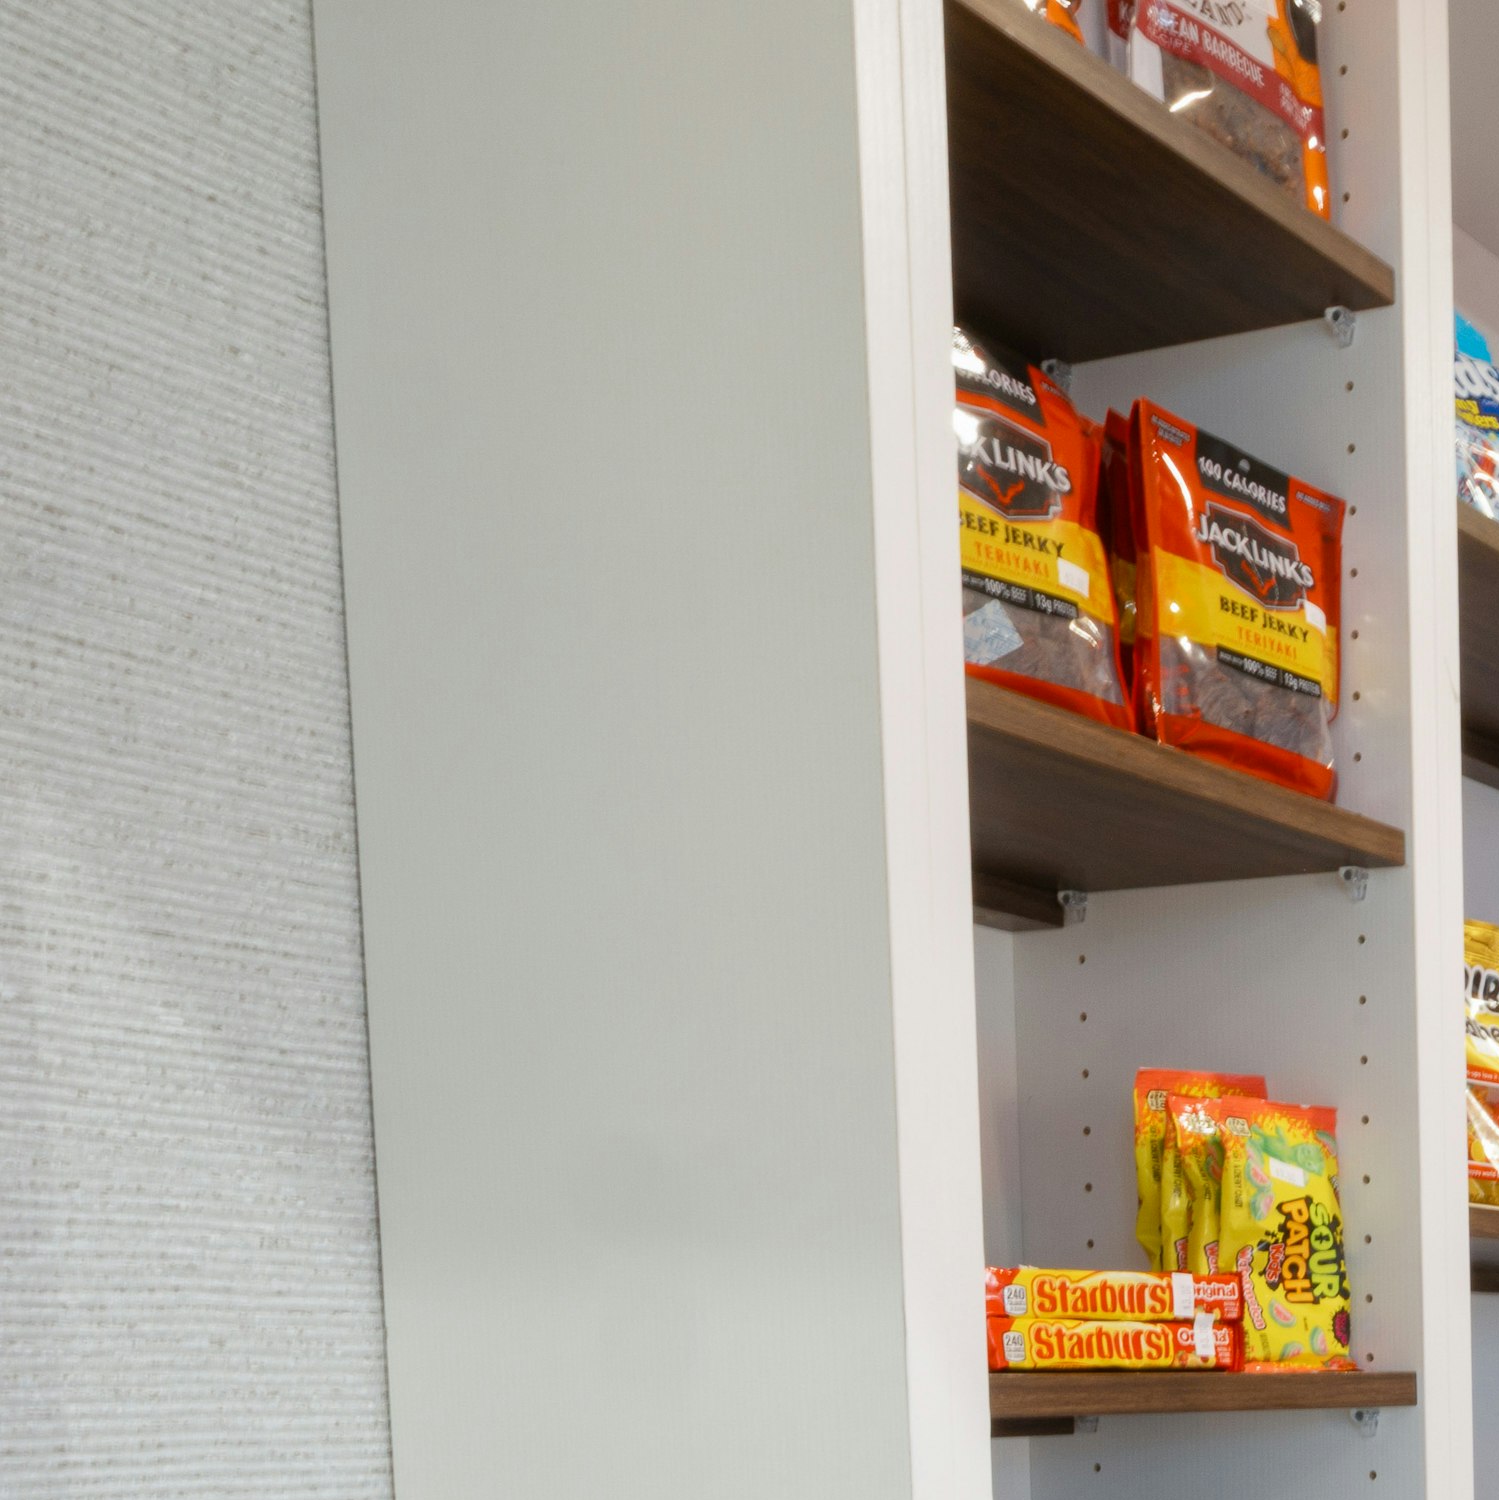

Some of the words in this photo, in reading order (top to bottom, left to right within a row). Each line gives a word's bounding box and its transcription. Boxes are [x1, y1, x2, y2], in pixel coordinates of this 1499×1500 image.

[1202, 29, 1266, 89] BARBECUE
[1198, 455, 1222, 482] 100
[1223, 472, 1287, 514] CALORIES
[974, 541, 1050, 578] TERIYAKI
[1004, 525, 1066, 558] JERKY
[1219, 595, 1258, 623] BEEF
[1262, 611, 1309, 643] JERKY
[1238, 625, 1298, 660] TERIYAKI
[1280, 1197, 1315, 1305] PATCH
[1309, 1202, 1340, 1299] SOUR
[1007, 1287, 1025, 1300] 240
[1034, 1275, 1175, 1315] Starburst
[1193, 1282, 1238, 1300] riginal
[1005, 1334, 1024, 1347] 240
[1032, 1322, 1172, 1361] Starburst
